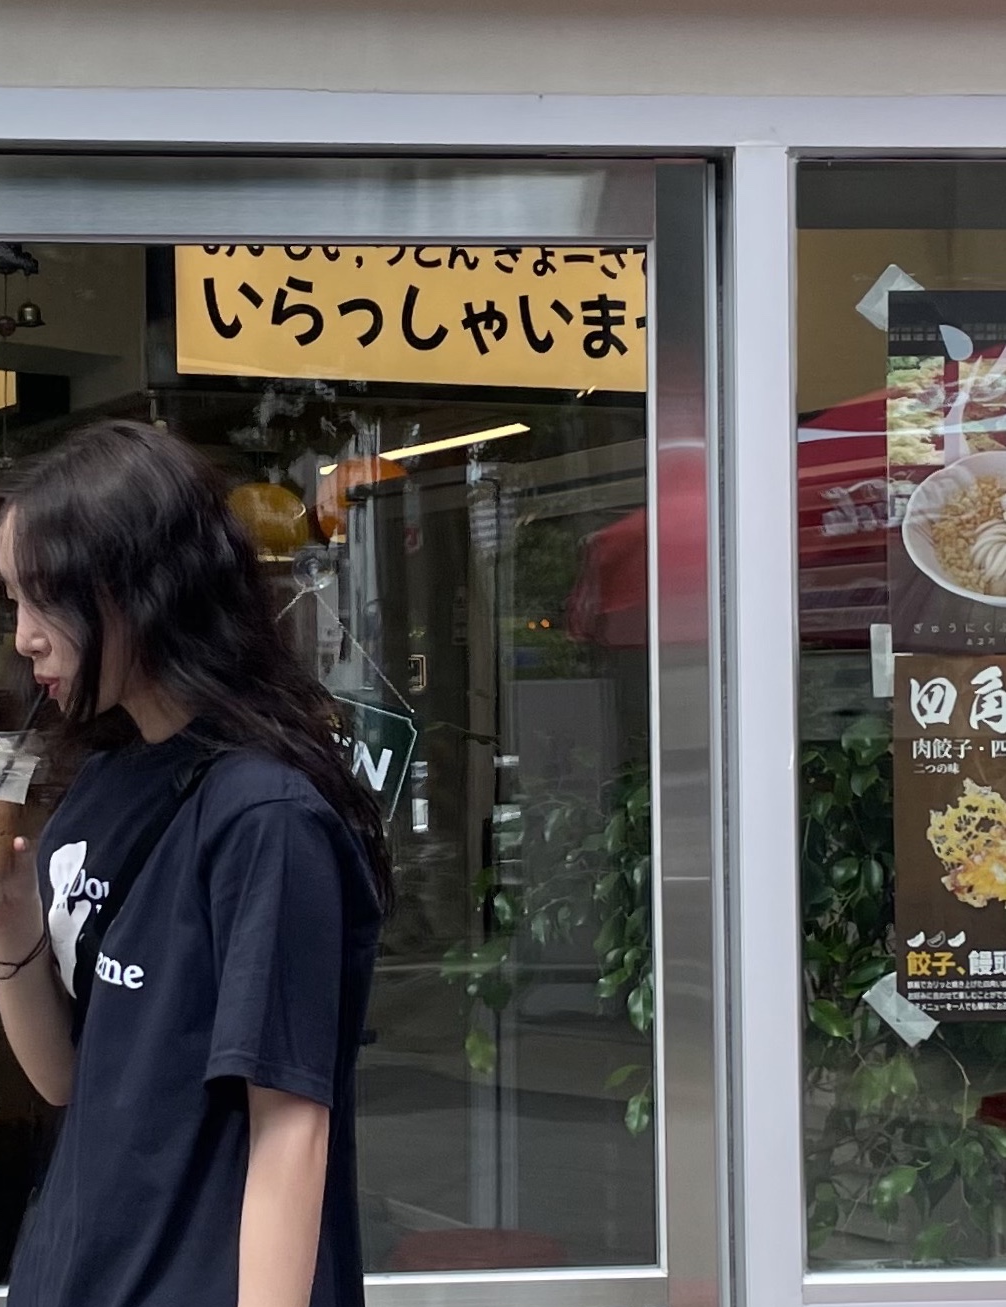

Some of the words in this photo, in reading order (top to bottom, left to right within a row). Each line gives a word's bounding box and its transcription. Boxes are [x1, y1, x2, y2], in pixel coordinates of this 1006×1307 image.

[203, 276, 646, 360] いらっしゃいま
[914, 762, 960, 775] 二つの味
